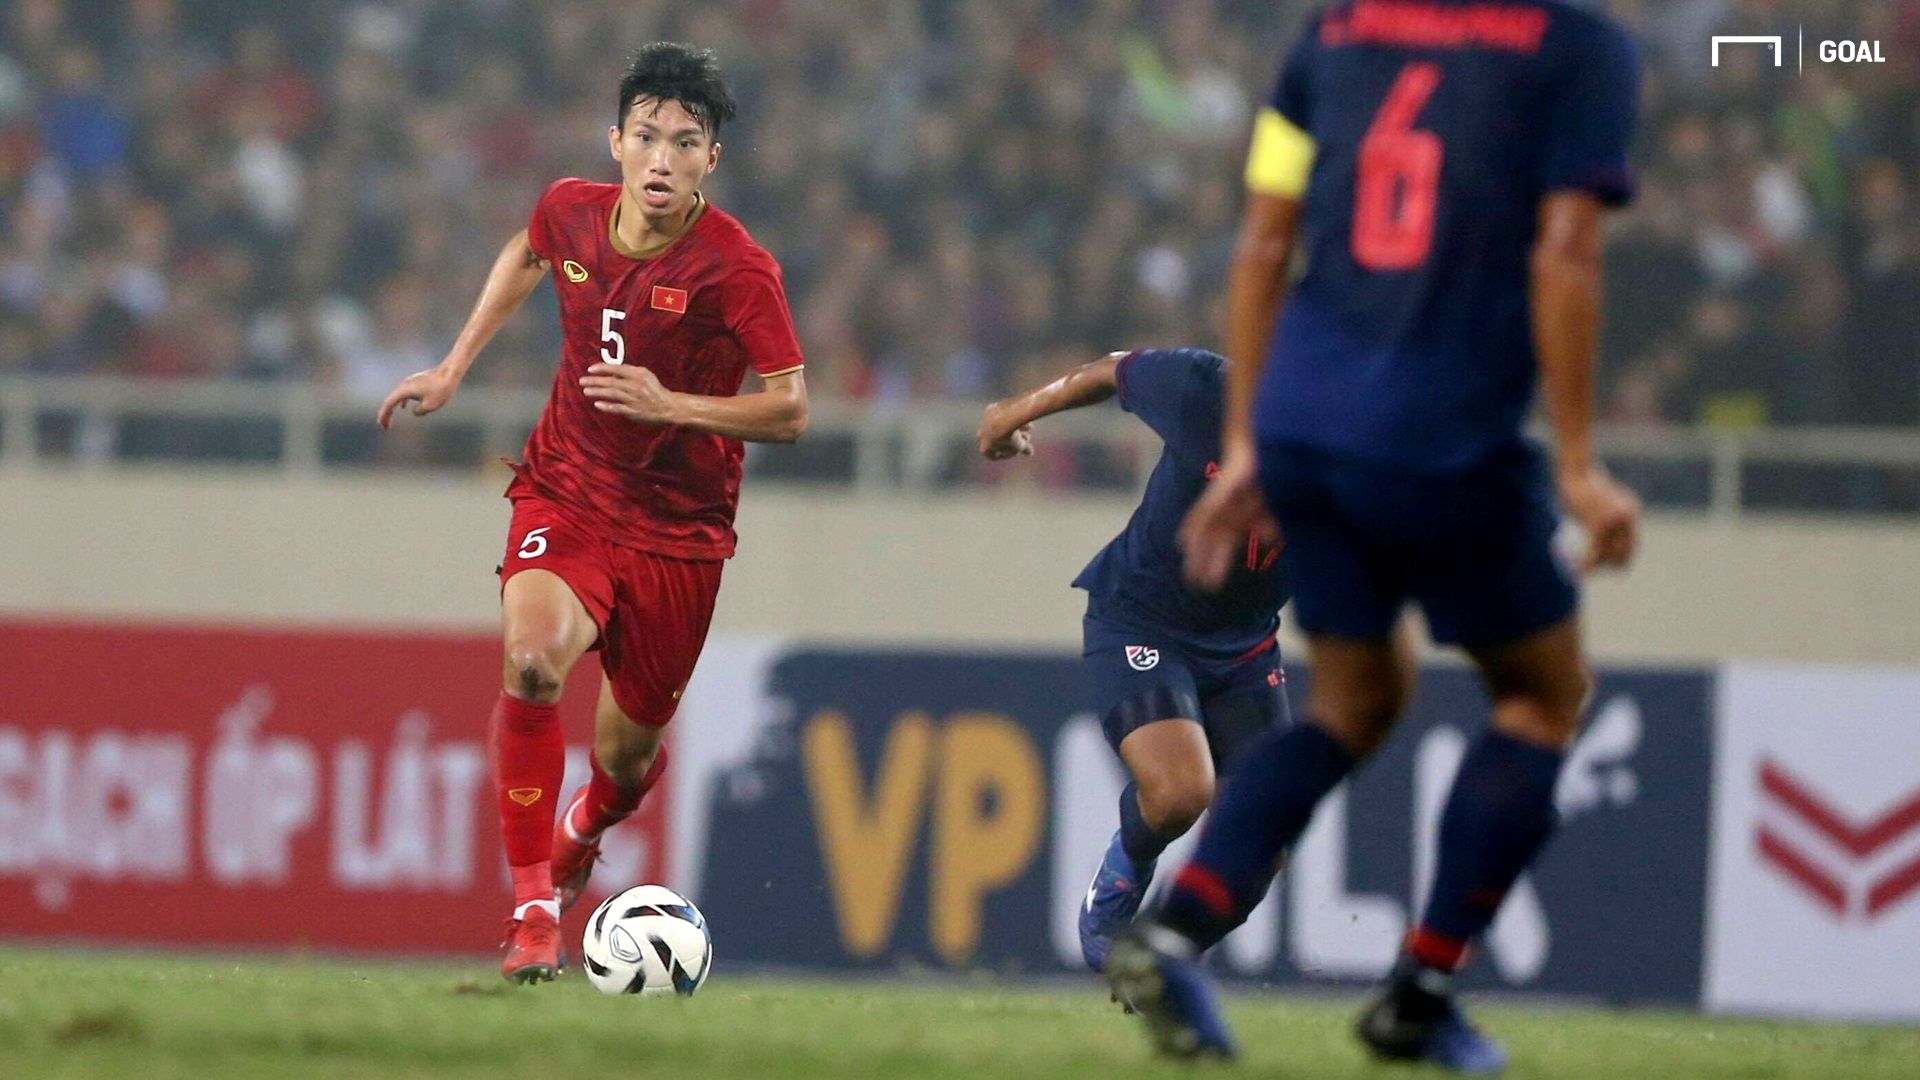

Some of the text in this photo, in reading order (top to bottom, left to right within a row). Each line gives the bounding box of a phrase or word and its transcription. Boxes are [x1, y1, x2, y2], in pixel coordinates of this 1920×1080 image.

[1353, 64, 1442, 269] 6
[601, 308, 626, 365] 5
[518, 526, 551, 559] 5
